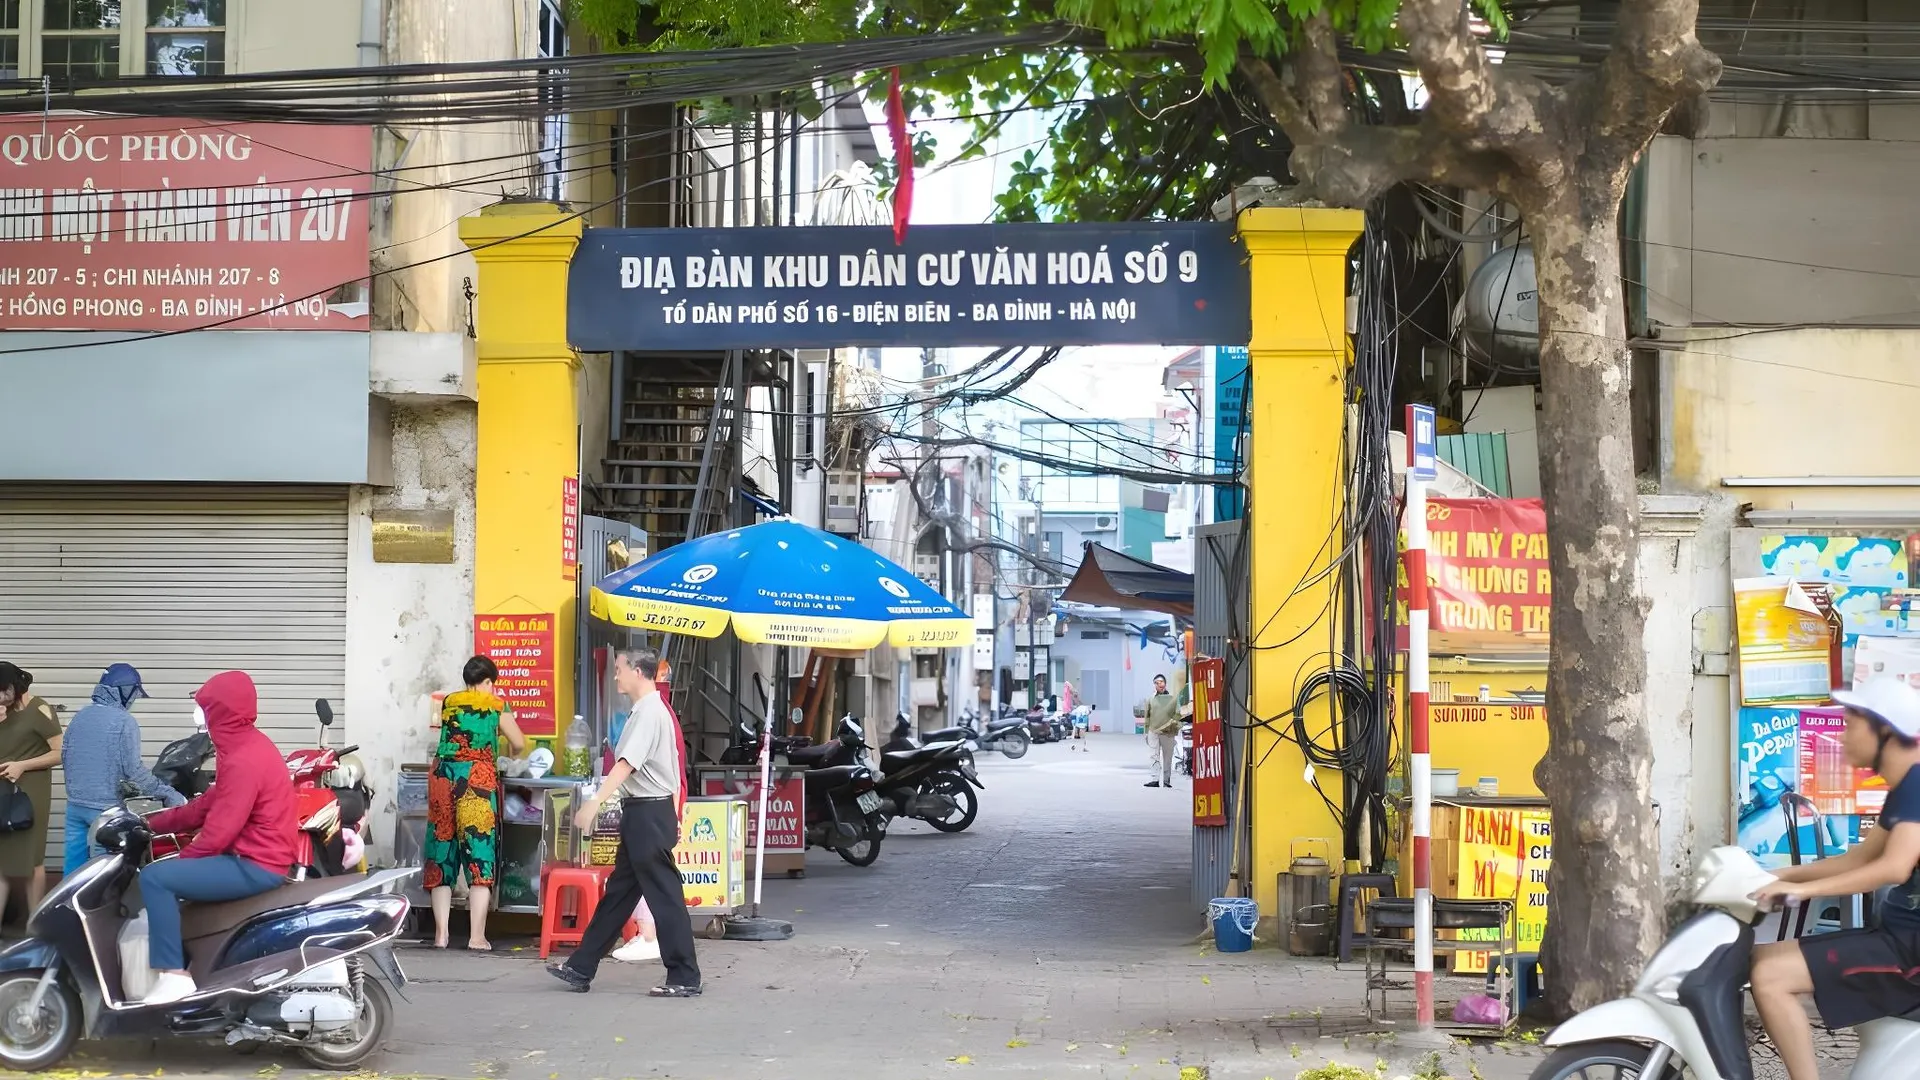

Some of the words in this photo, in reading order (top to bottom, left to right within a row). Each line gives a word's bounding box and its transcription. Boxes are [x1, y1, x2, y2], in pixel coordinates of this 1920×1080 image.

[2, 124, 109, 166] QUỐC
[120, 128, 252, 162] PHÒNG
[121, 177, 217, 242] THÀNH
[226, 174, 291, 242] VIÊN
[300, 186, 353, 242] 207
[26, 268, 58, 286] 207
[75, 268, 87, 286] 5
[103, 268, 137, 286] CHI
[142, 263, 213, 286] NHÁNH
[218, 268, 251, 286] 207
[269, 267, 280, 286] 8
[686, 249, 752, 288] BÀN
[764, 255, 829, 288] KHU
[839, 248, 906, 288] DÂN
[917, 249, 966, 287] CƯ
[970, 245, 1038, 286] VĂN
[1047, 244, 1114, 286] HOÁ
[1124, 241, 1170, 285] SỐ
[1178, 250, 1199, 284] 9
[73, 298, 144, 317] PHONG
[161, 299, 189, 317] BA
[261, 293, 290, 317] HÀ
[295, 294, 329, 321] NỘI
[692, 302, 732, 324] DÂN
[738, 299, 778, 324] PHỐ
[783, 298, 810, 324] SỐ
[816, 304, 838, 324] 16
[904, 300, 951, 323] BIÊN
[972, 303, 999, 322] BA
[1004, 298, 1052, 322] ĐÌNH
[1069, 298, 1096, 320] HÀ
[1101, 298, 1136, 323] NỘI
